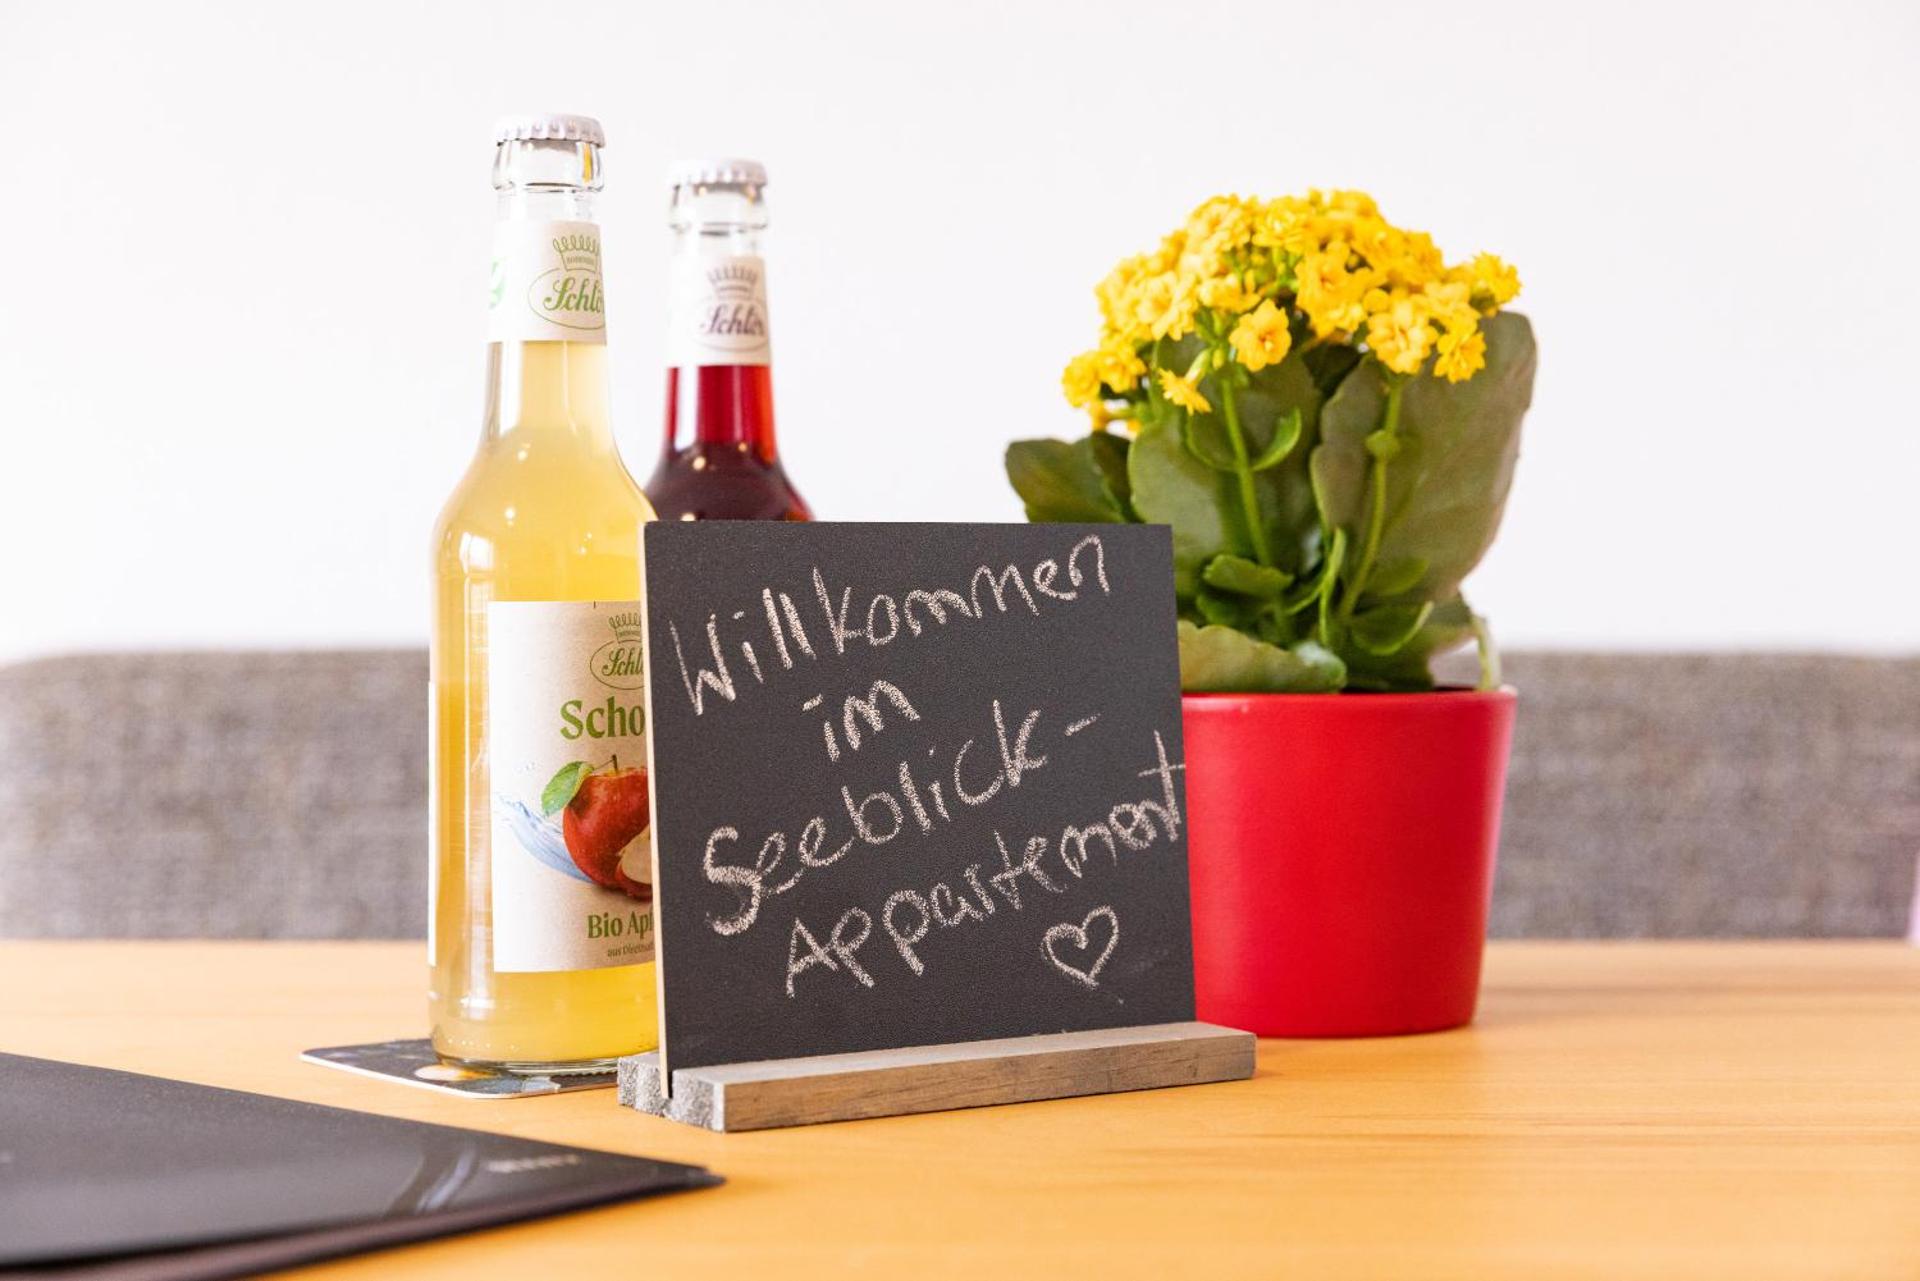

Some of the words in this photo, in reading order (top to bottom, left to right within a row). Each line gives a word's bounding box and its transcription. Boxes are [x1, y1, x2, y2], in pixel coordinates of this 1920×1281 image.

[669, 534, 1110, 715] Willkommen
[560, 696, 646, 740] Scho
[802, 680, 920, 762] im
[786, 730, 1187, 998] Appartement
[588, 912, 622, 938] Bio
